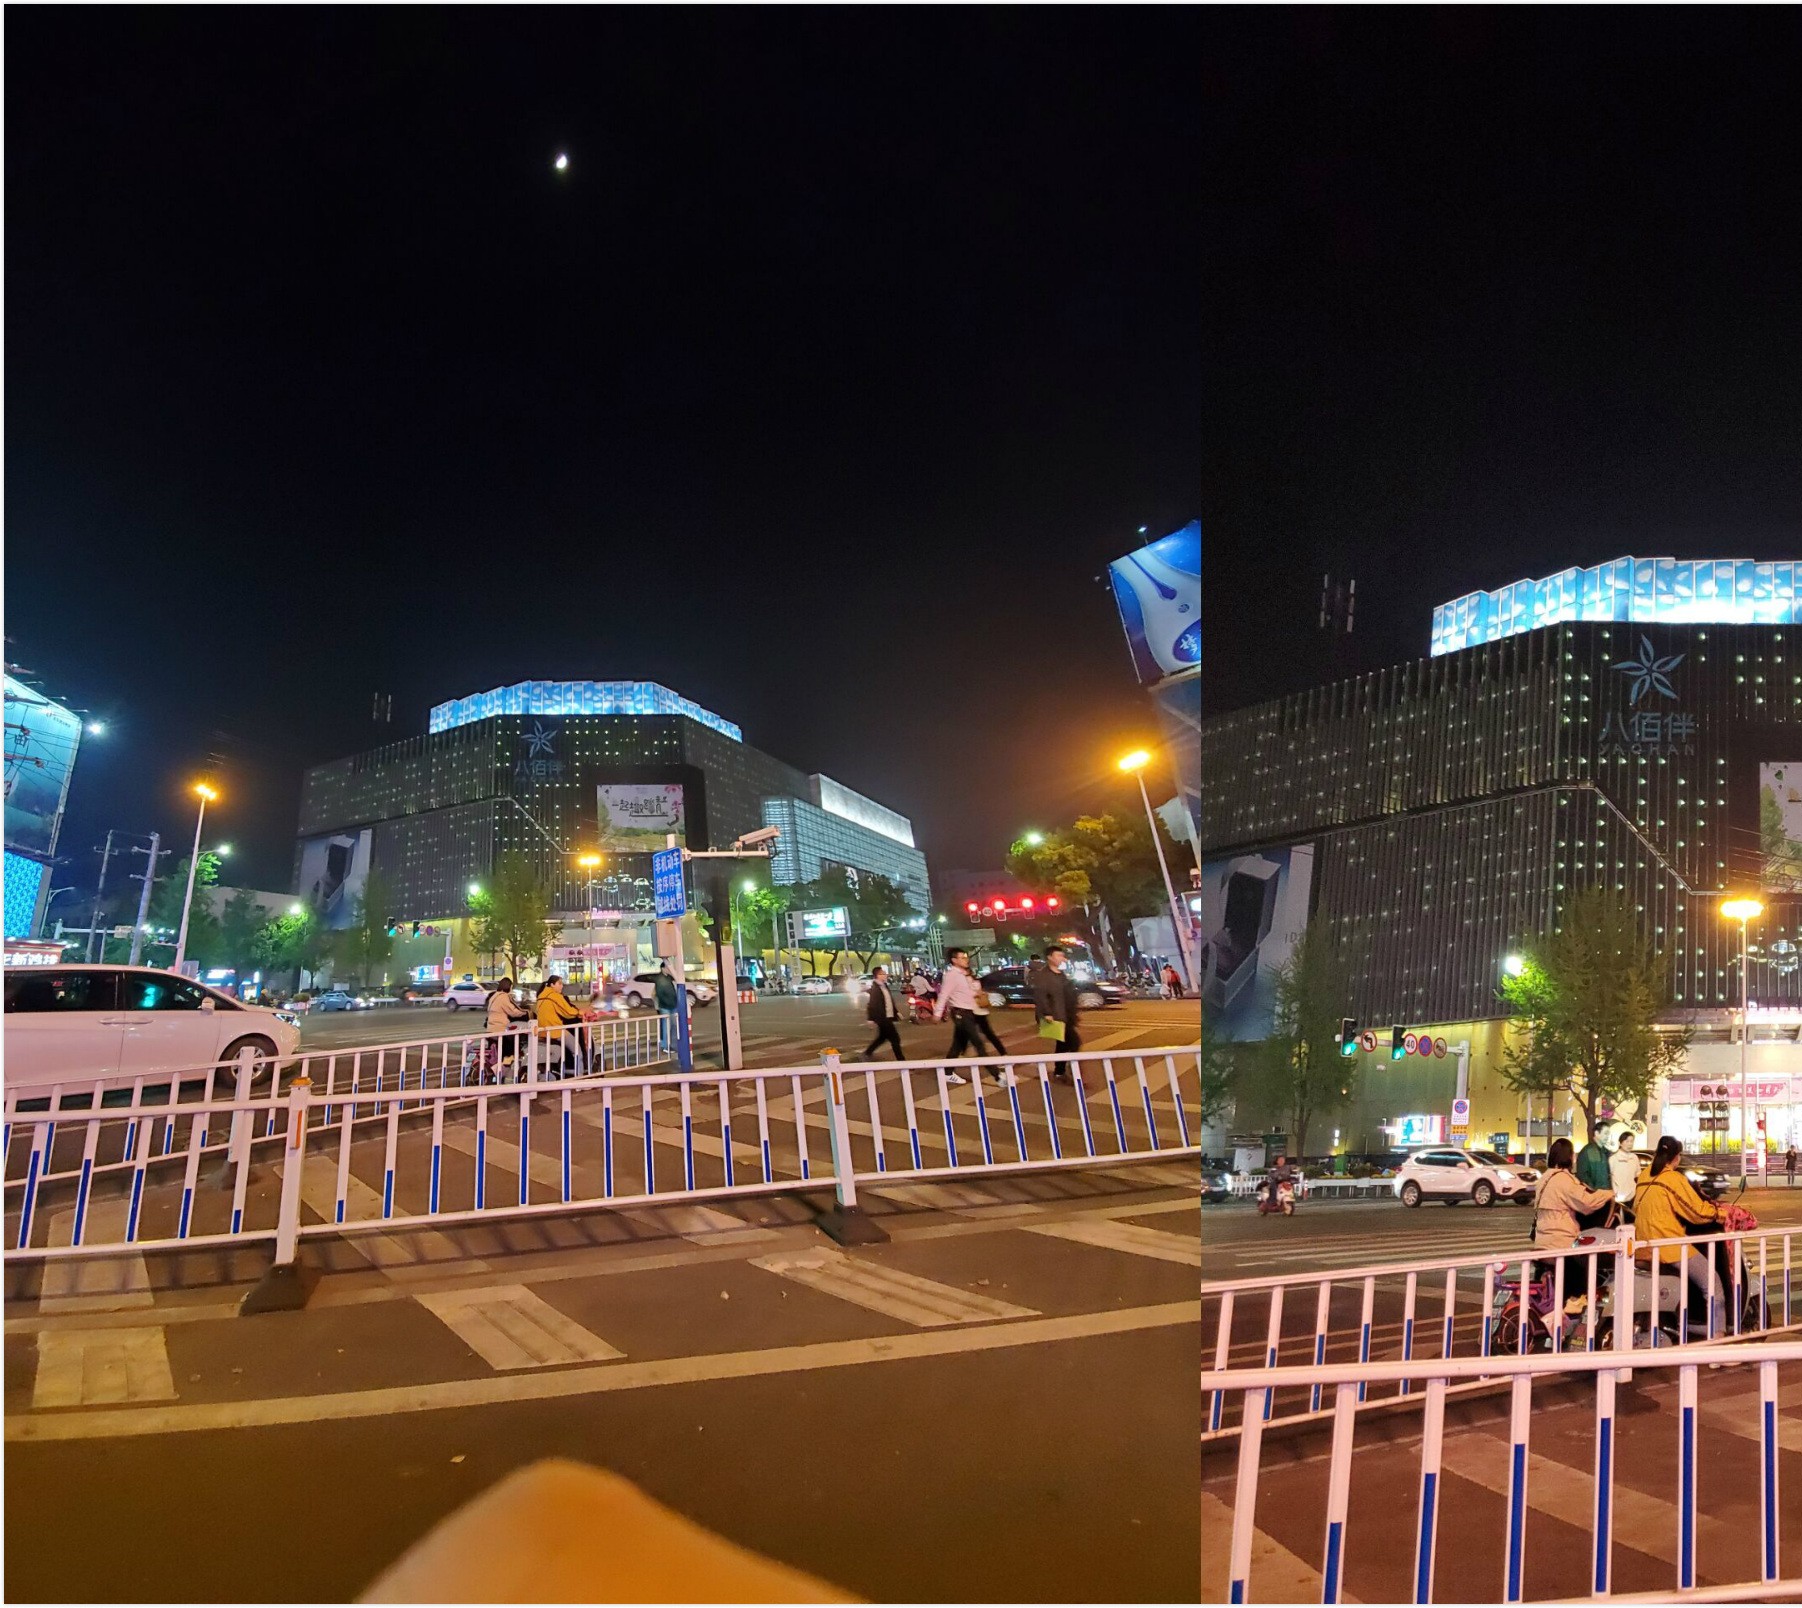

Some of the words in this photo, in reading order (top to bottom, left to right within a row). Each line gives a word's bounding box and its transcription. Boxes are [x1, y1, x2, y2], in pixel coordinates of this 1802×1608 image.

[1598, 712, 1696, 742] 八佰伴
[1599, 742, 1695, 756] YAOHAN
[514, 759, 563, 776] 八佰伴
[1405, 1039, 1415, 1047] 40
